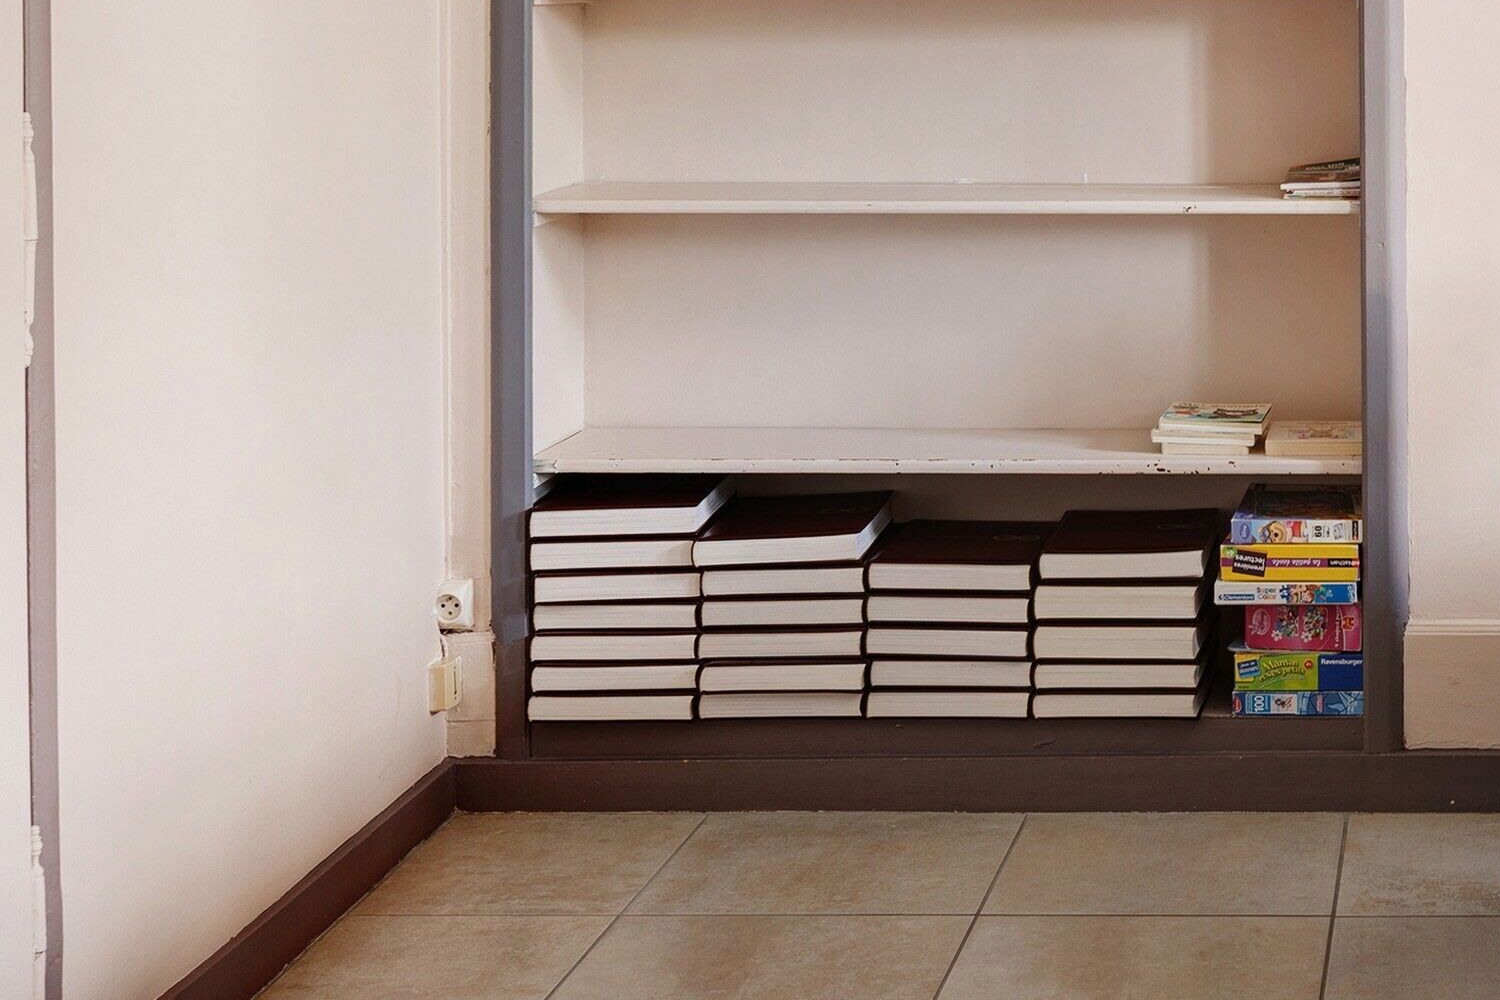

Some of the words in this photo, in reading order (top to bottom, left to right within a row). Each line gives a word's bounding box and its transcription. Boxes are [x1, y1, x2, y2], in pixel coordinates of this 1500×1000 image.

[1235, 555, 1265, 564] lectures
[1233, 562, 1264, 572] premières
[1321, 658, 1363, 666] Ravensburger
[1254, 695, 1264, 712] 100
